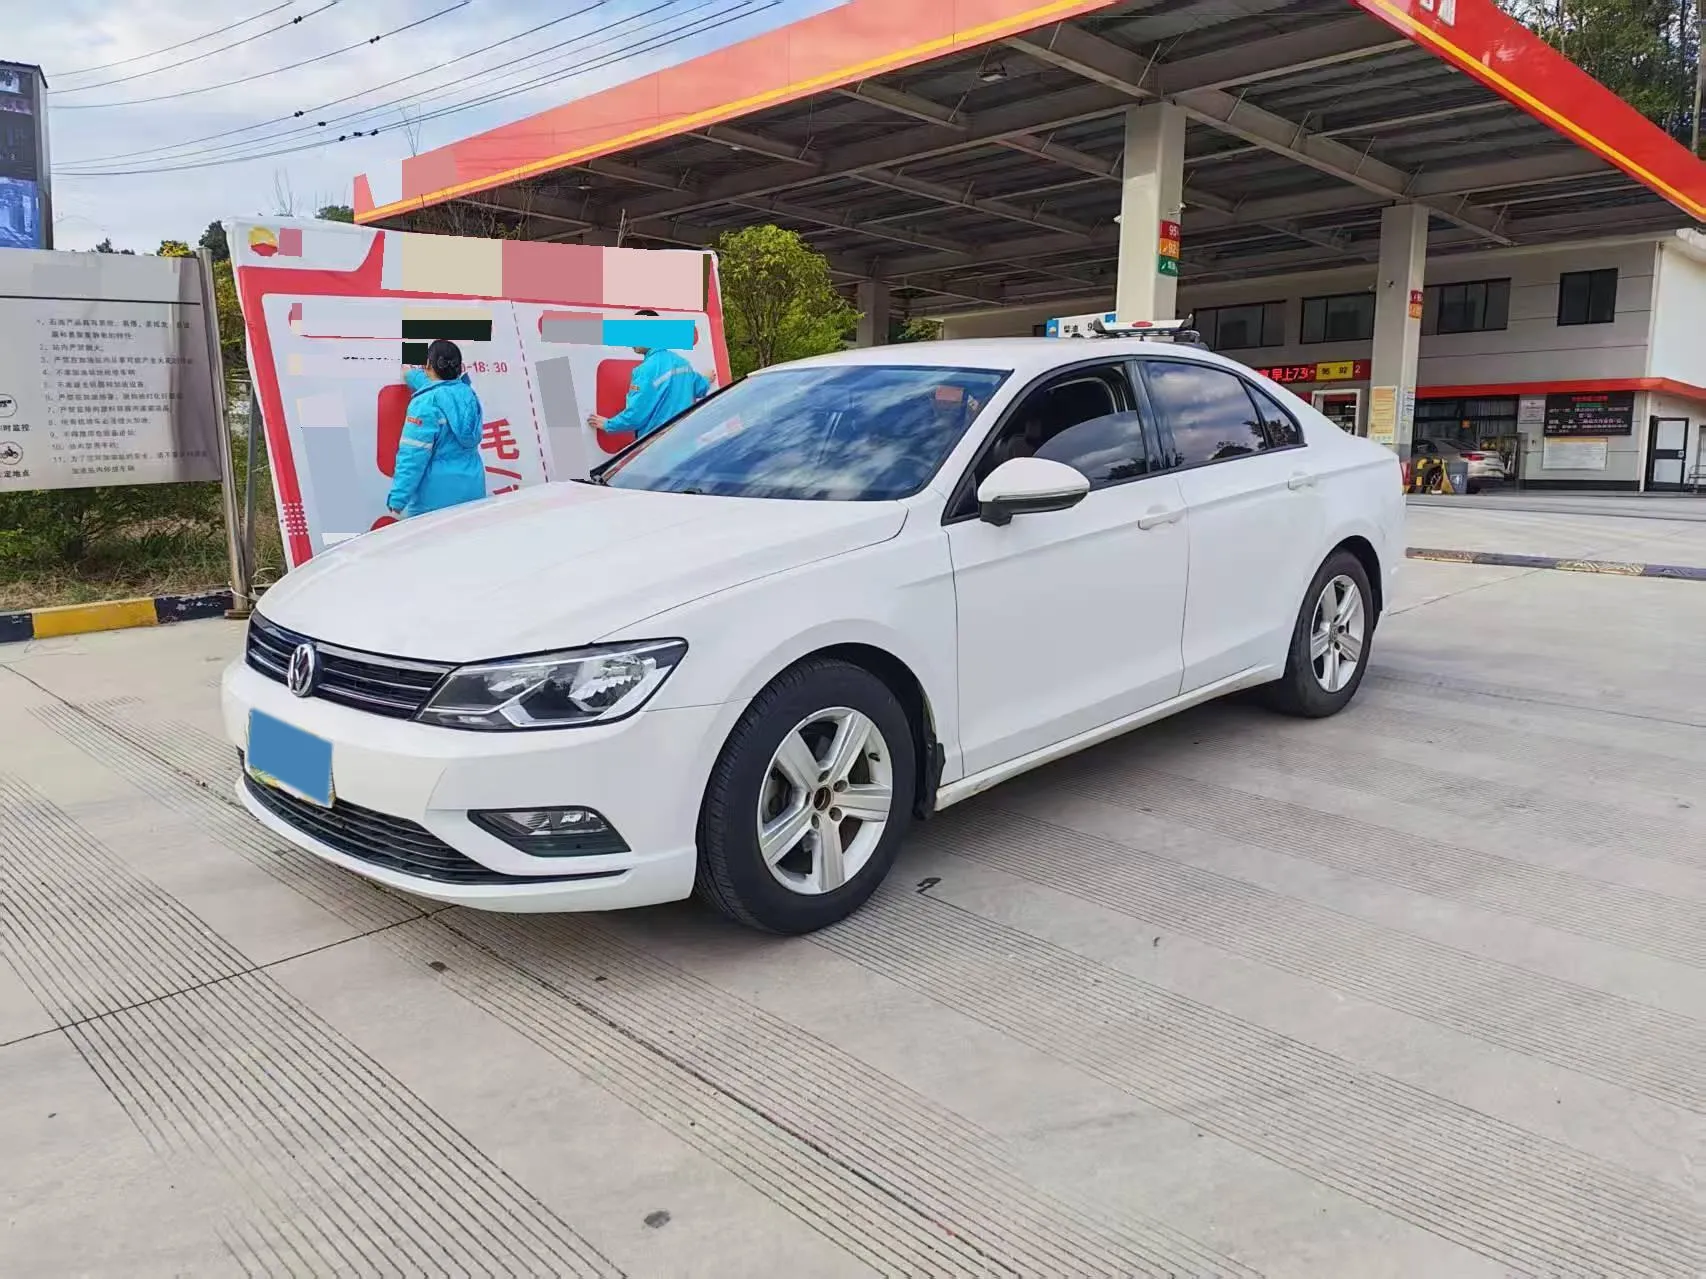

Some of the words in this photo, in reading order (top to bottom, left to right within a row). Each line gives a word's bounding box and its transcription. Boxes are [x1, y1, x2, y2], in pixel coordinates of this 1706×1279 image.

[0, 423, 31, 432] 时监控
[480, 418, 520, 460] 毛
[0, 469, 31, 479] 定地点
